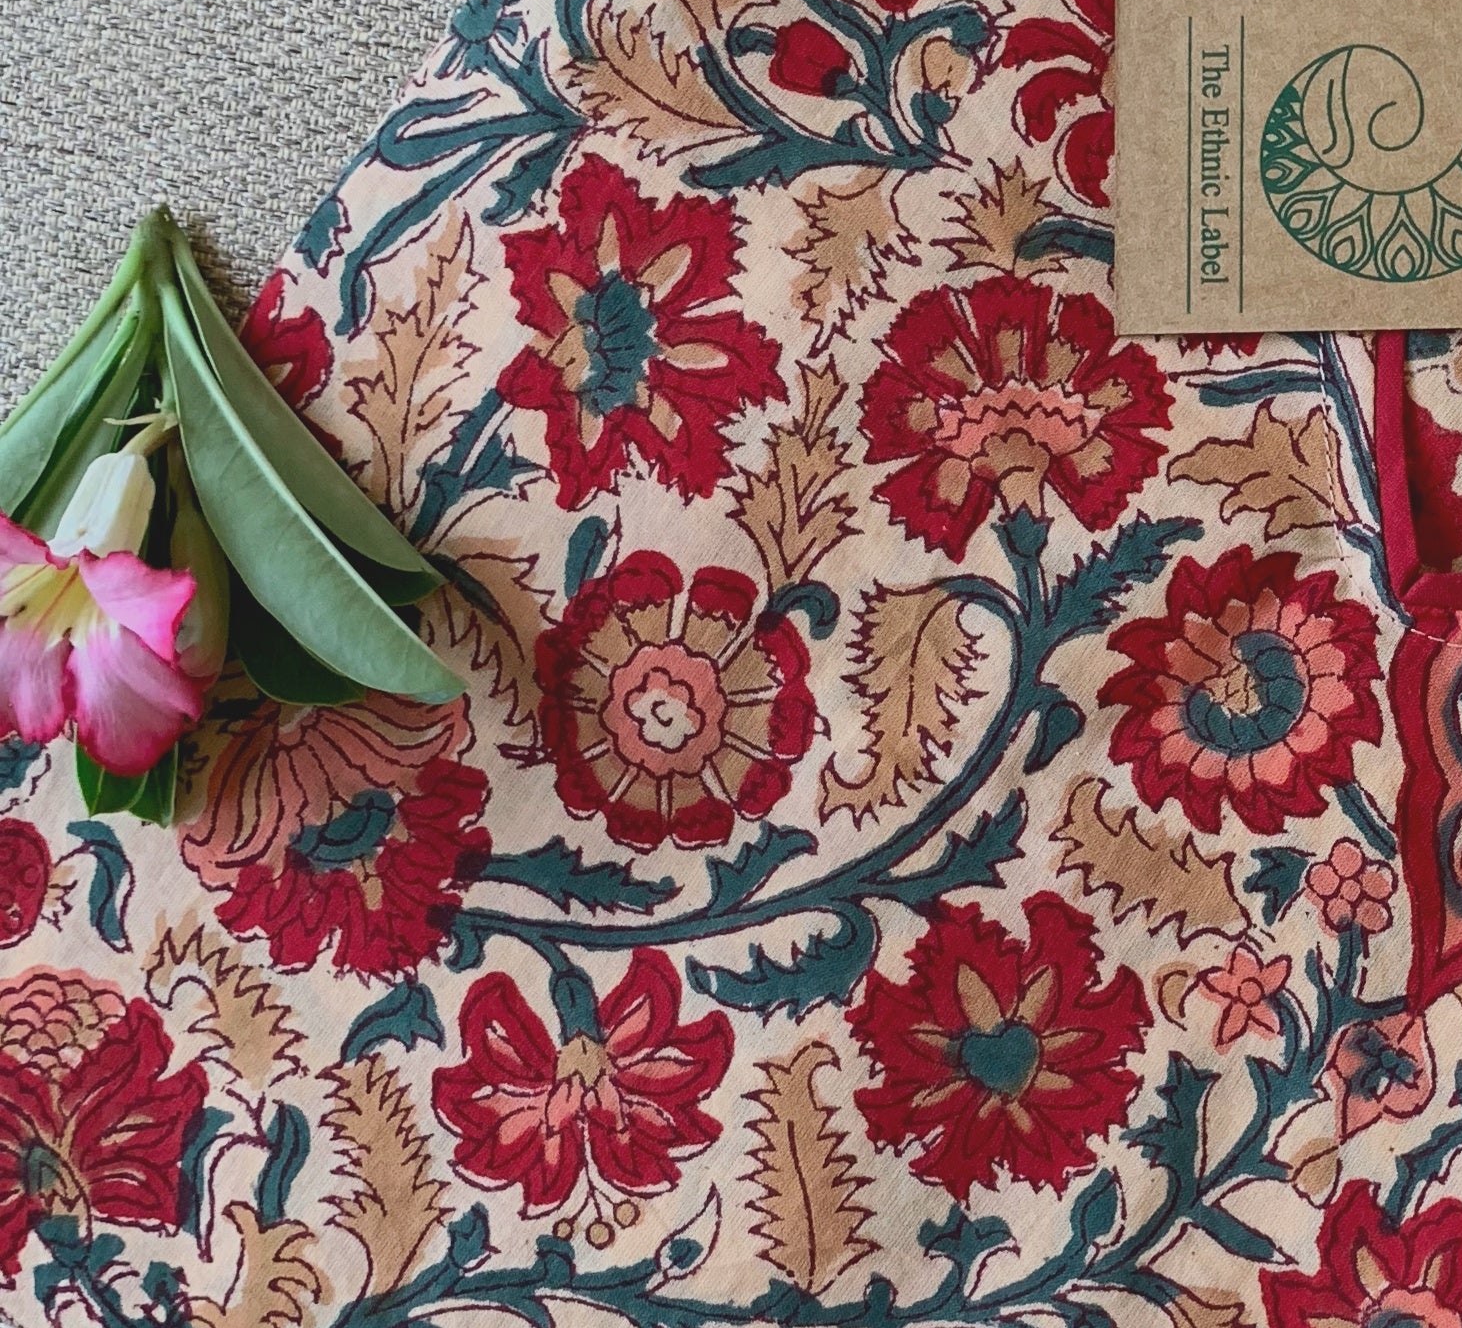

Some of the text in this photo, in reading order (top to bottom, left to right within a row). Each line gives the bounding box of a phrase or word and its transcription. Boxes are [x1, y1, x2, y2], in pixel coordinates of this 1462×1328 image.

[1201, 44, 1230, 285] The Ethnic Label
